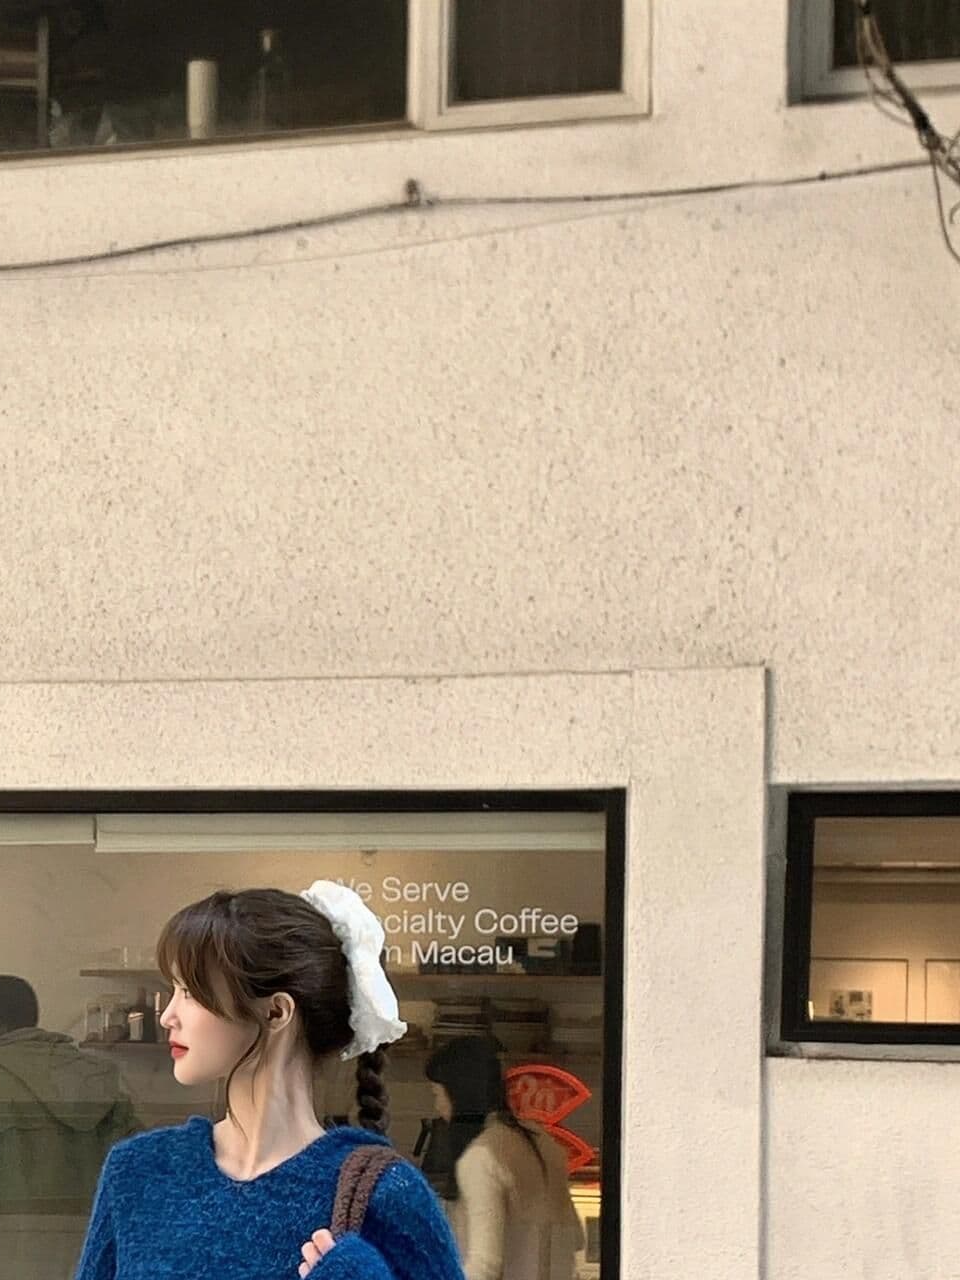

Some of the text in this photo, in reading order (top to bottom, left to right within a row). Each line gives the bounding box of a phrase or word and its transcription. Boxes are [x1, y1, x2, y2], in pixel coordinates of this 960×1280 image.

[382, 876, 470, 902] Serve
[378, 907, 580, 939] cialty Coffee
[411, 940, 514, 965] Macau
